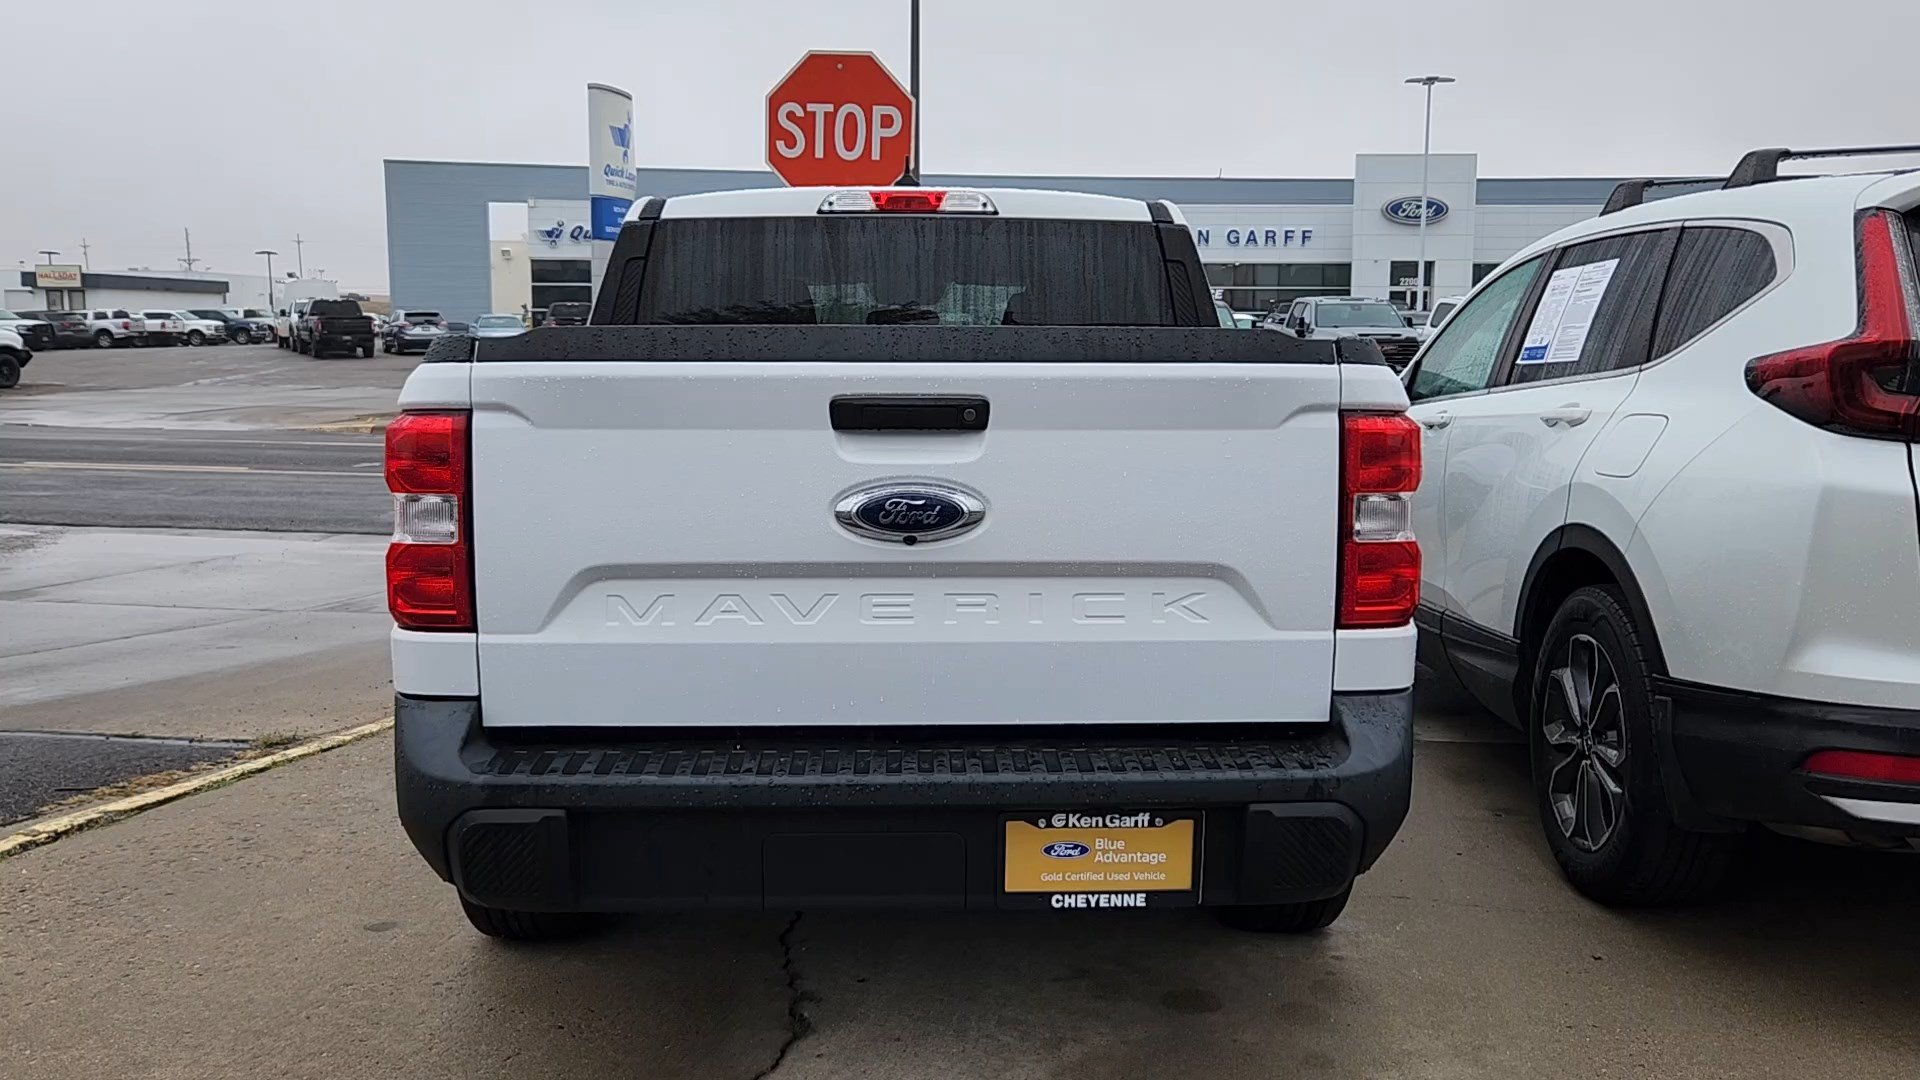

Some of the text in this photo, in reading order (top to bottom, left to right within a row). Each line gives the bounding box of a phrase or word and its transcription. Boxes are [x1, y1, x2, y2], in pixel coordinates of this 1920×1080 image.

[775, 101, 903, 161] STOP
[604, 164, 625, 178] Quick
[570, 225, 592, 241] Qu
[1197, 229, 1313, 246] N GARFF
[878, 498, 942, 525] Ford
[605, 592, 1210, 626] MAVERICK
[1068, 812, 1151, 828] Ken Garff
[1050, 844, 1081, 857] Ford
[1095, 838, 1125, 850] Blue
[1094, 851, 1167, 865] Advantage
[1040, 871, 1166, 882] Gold Certified Used Vehicle
[1051, 893, 1147, 908] CHEYENNE
